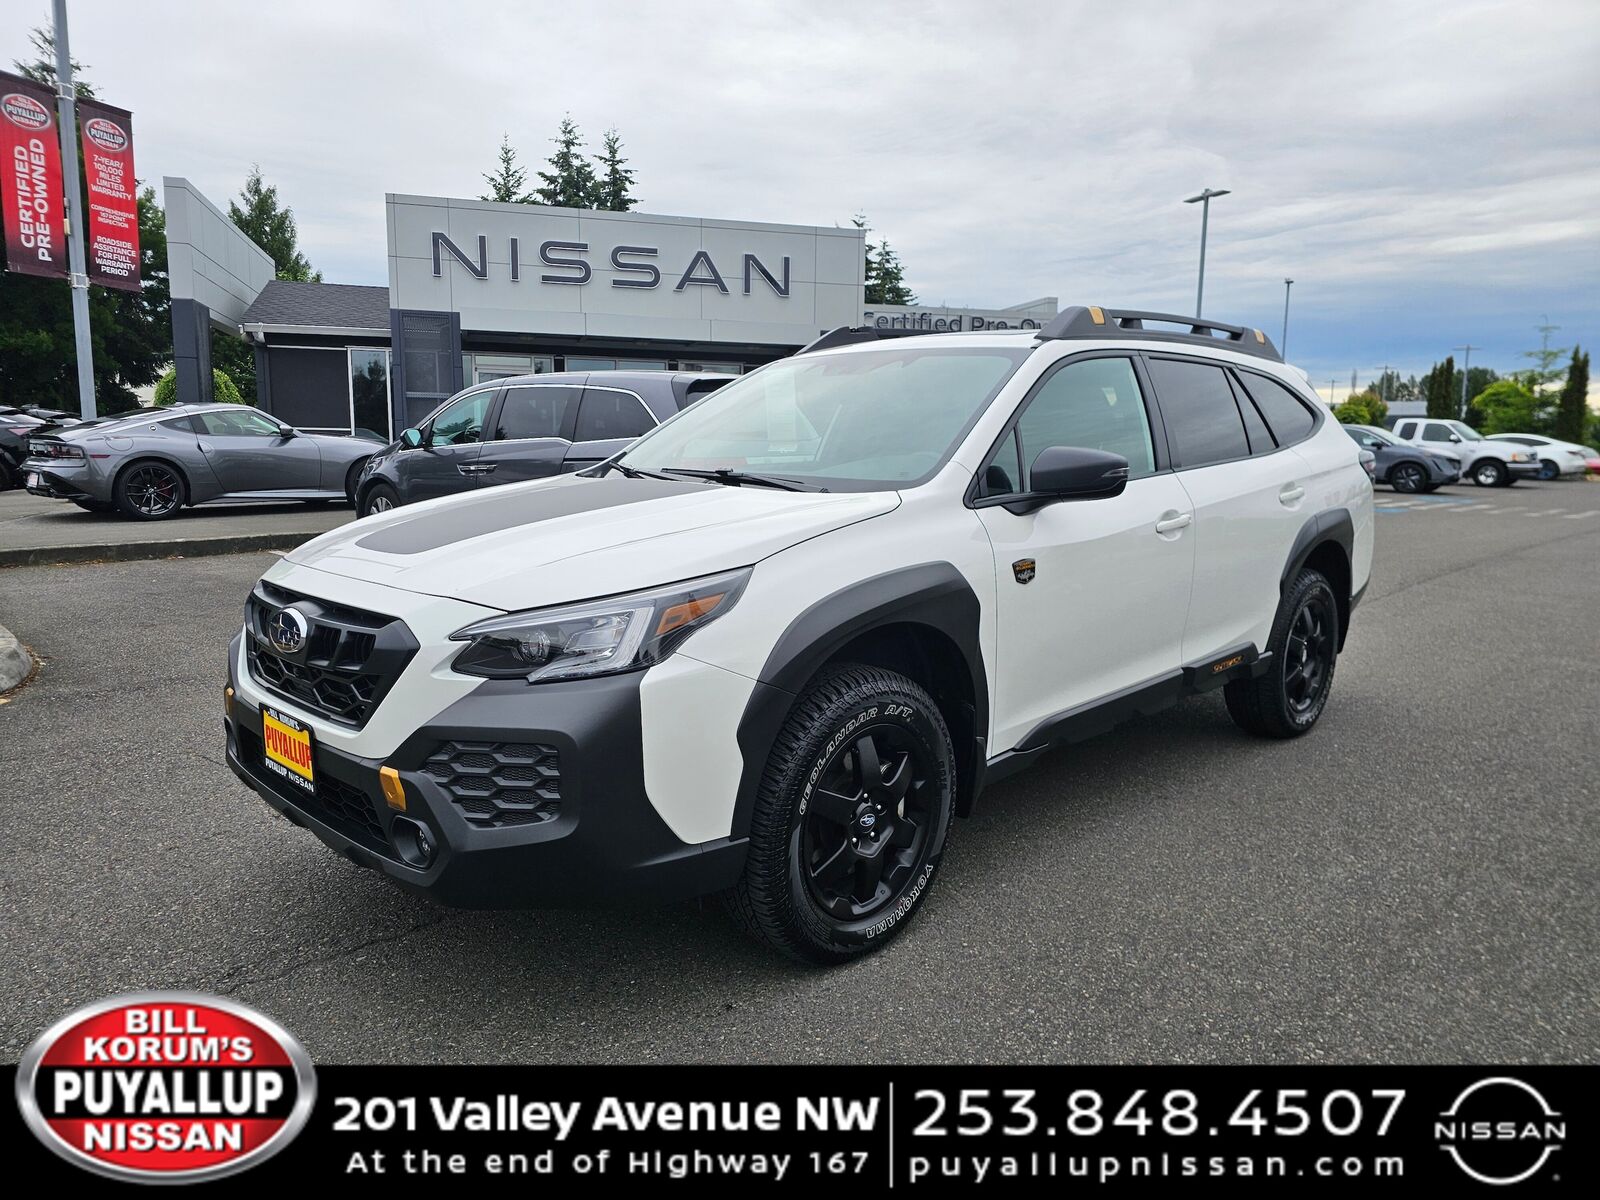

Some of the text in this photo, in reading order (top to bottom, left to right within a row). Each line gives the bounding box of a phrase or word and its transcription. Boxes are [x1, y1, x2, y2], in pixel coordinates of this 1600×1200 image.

[5, 104, 46, 122] PUYALLUP
[90, 128, 124, 144] PUYALLUP
[93, 154, 124, 169] 7-YEAR/
[93, 162, 124, 176] 100,000
[96, 178, 125, 192] LIMITED
[99, 171, 121, 184] MILES
[14, 145, 35, 248] CERTIFIED
[91, 184, 132, 200] WARRANTY
[30, 138, 52, 262] PRE-OWNED
[91, 203, 135, 219] COMPREHENSIVE
[108, 213, 126, 222] POINT
[97, 217, 129, 228] INSPECTION
[93, 242, 136, 257] ASSISTANCE
[96, 235, 133, 249] ROADSIDE
[95, 257, 136, 271] WARRANTY
[98, 250, 132, 264] FOR FULL
[430, 230, 793, 299] NISSAN
[101, 265, 129, 277] PERIOD
[265, 724, 312, 770] PUYALLUP
[799, 706, 878, 815] GEOLANDAR
[265, 757, 314, 793] PUYALLUP NISSAN
[865, 863, 934, 939] YOKOHAMA
